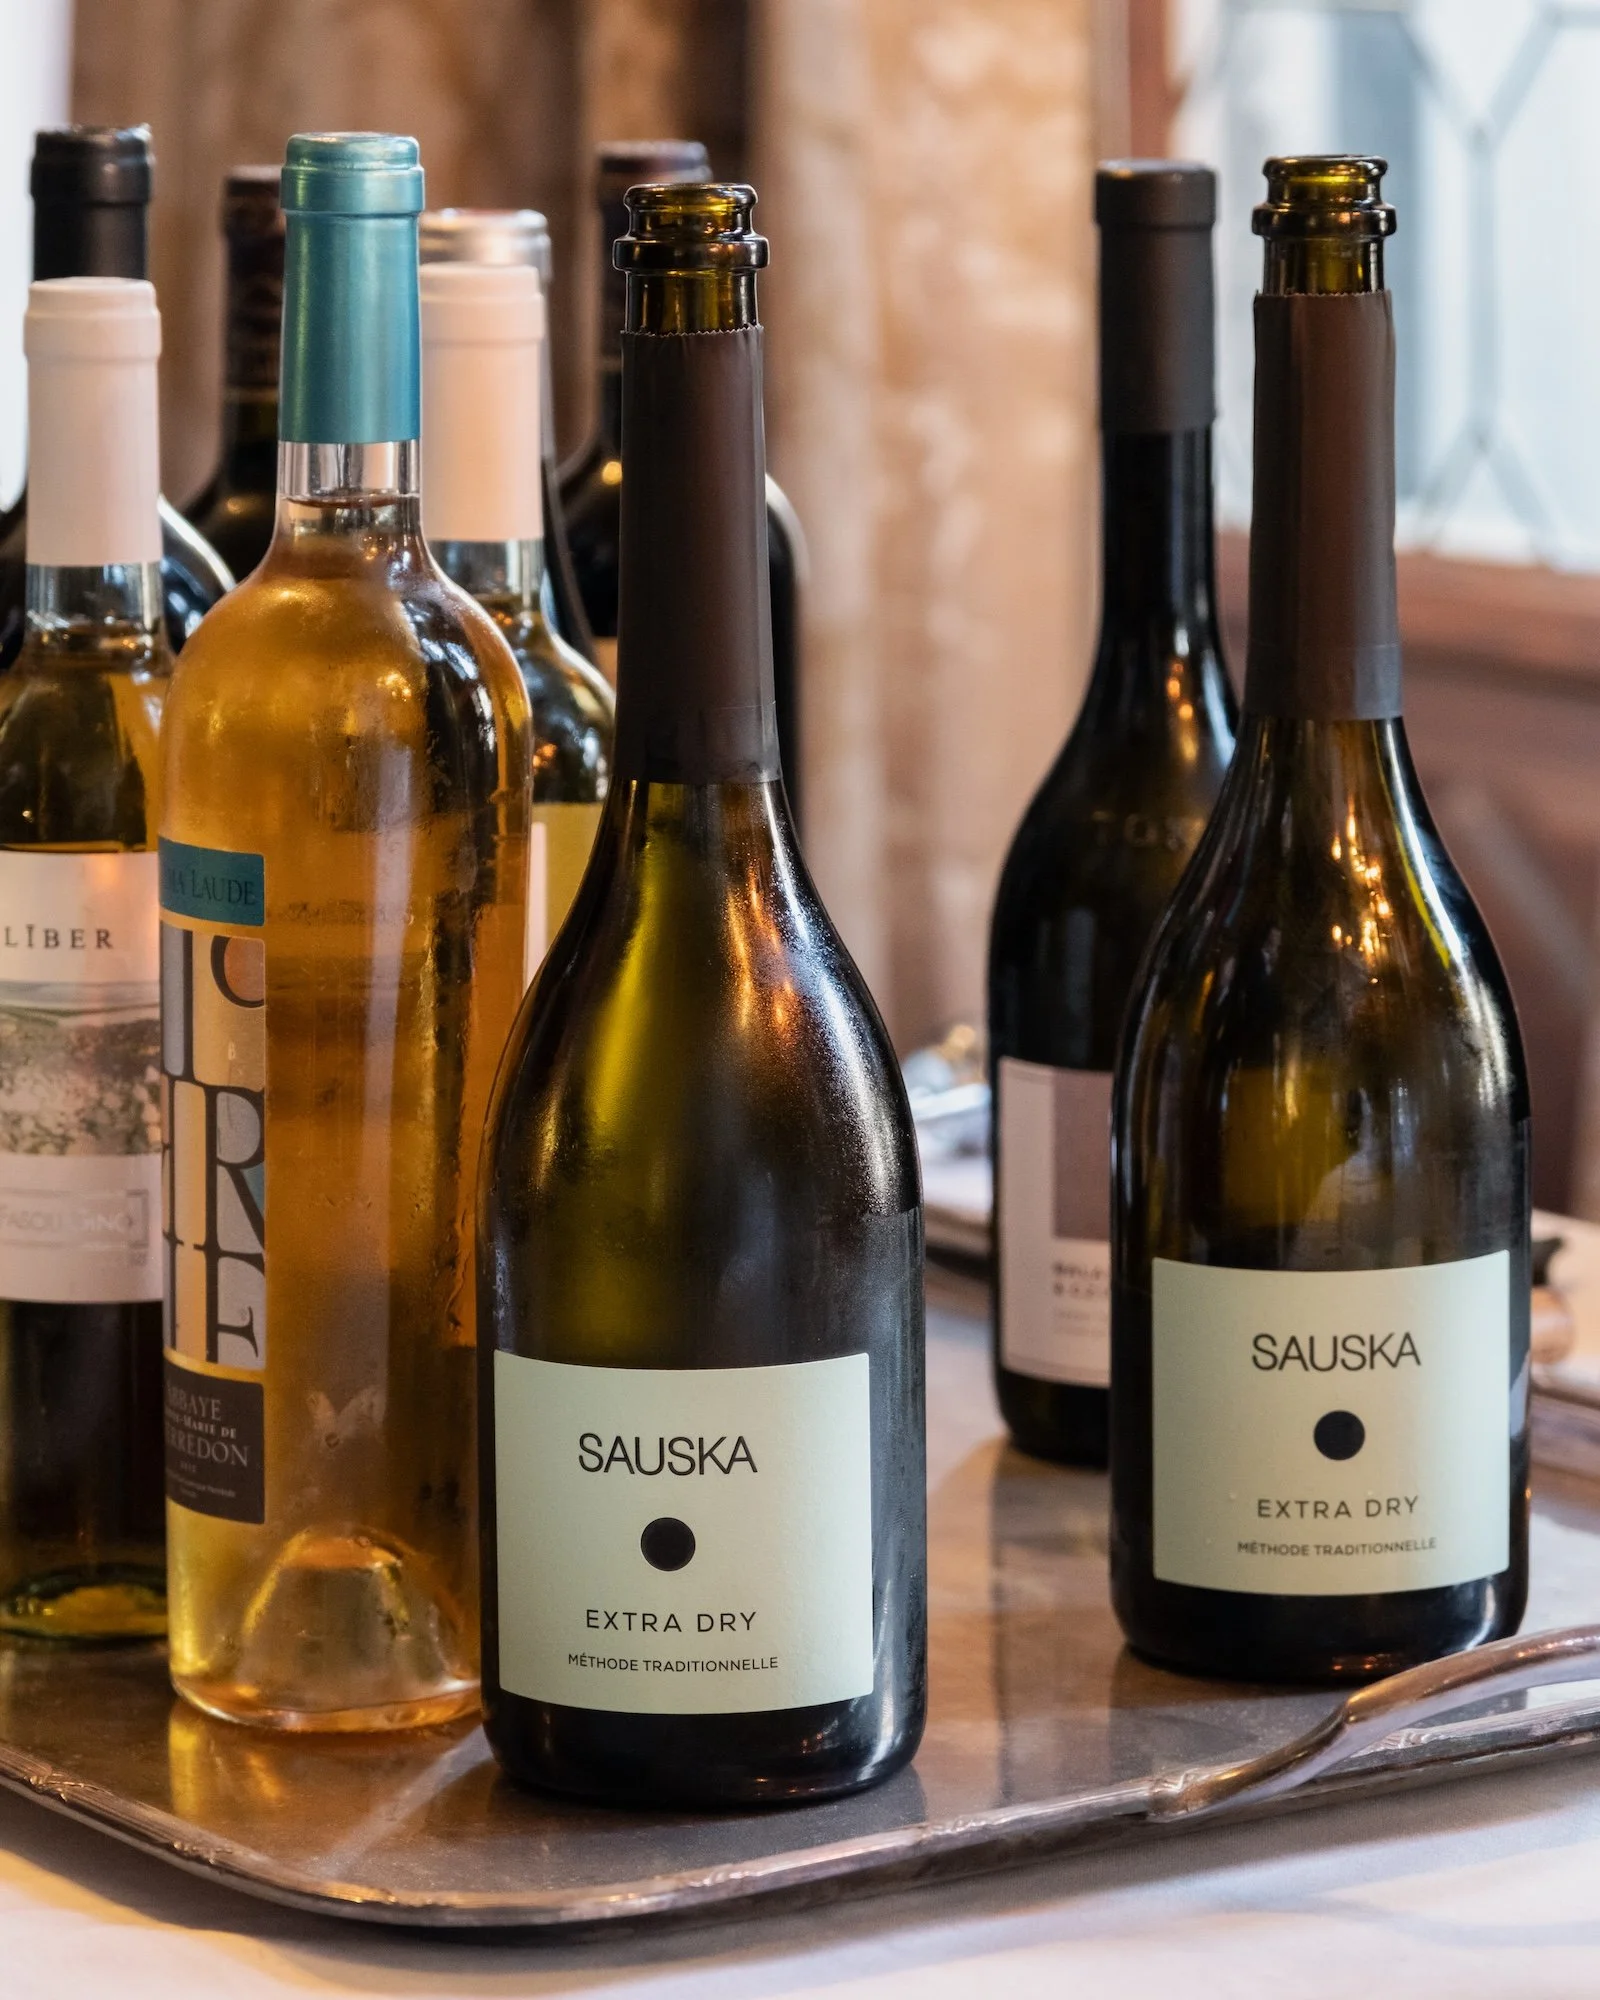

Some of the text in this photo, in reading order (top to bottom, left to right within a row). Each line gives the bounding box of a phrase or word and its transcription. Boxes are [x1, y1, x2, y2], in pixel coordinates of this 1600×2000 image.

[192, 869, 257, 906] LAUDE
[1251, 1331, 1422, 1372] SAUSKA
[220, 1428, 237, 1440] DE
[578, 1432, 758, 1477] SAUSKA
[1257, 1495, 1418, 1519] EXTRA DRY
[1237, 1537, 1437, 1556] MÉTHODE TRADITIONNELLE
[586, 1608, 757, 1633] EXTRA DRY
[568, 1652, 779, 1673] MÉTHODE TRADITIONNELLE
